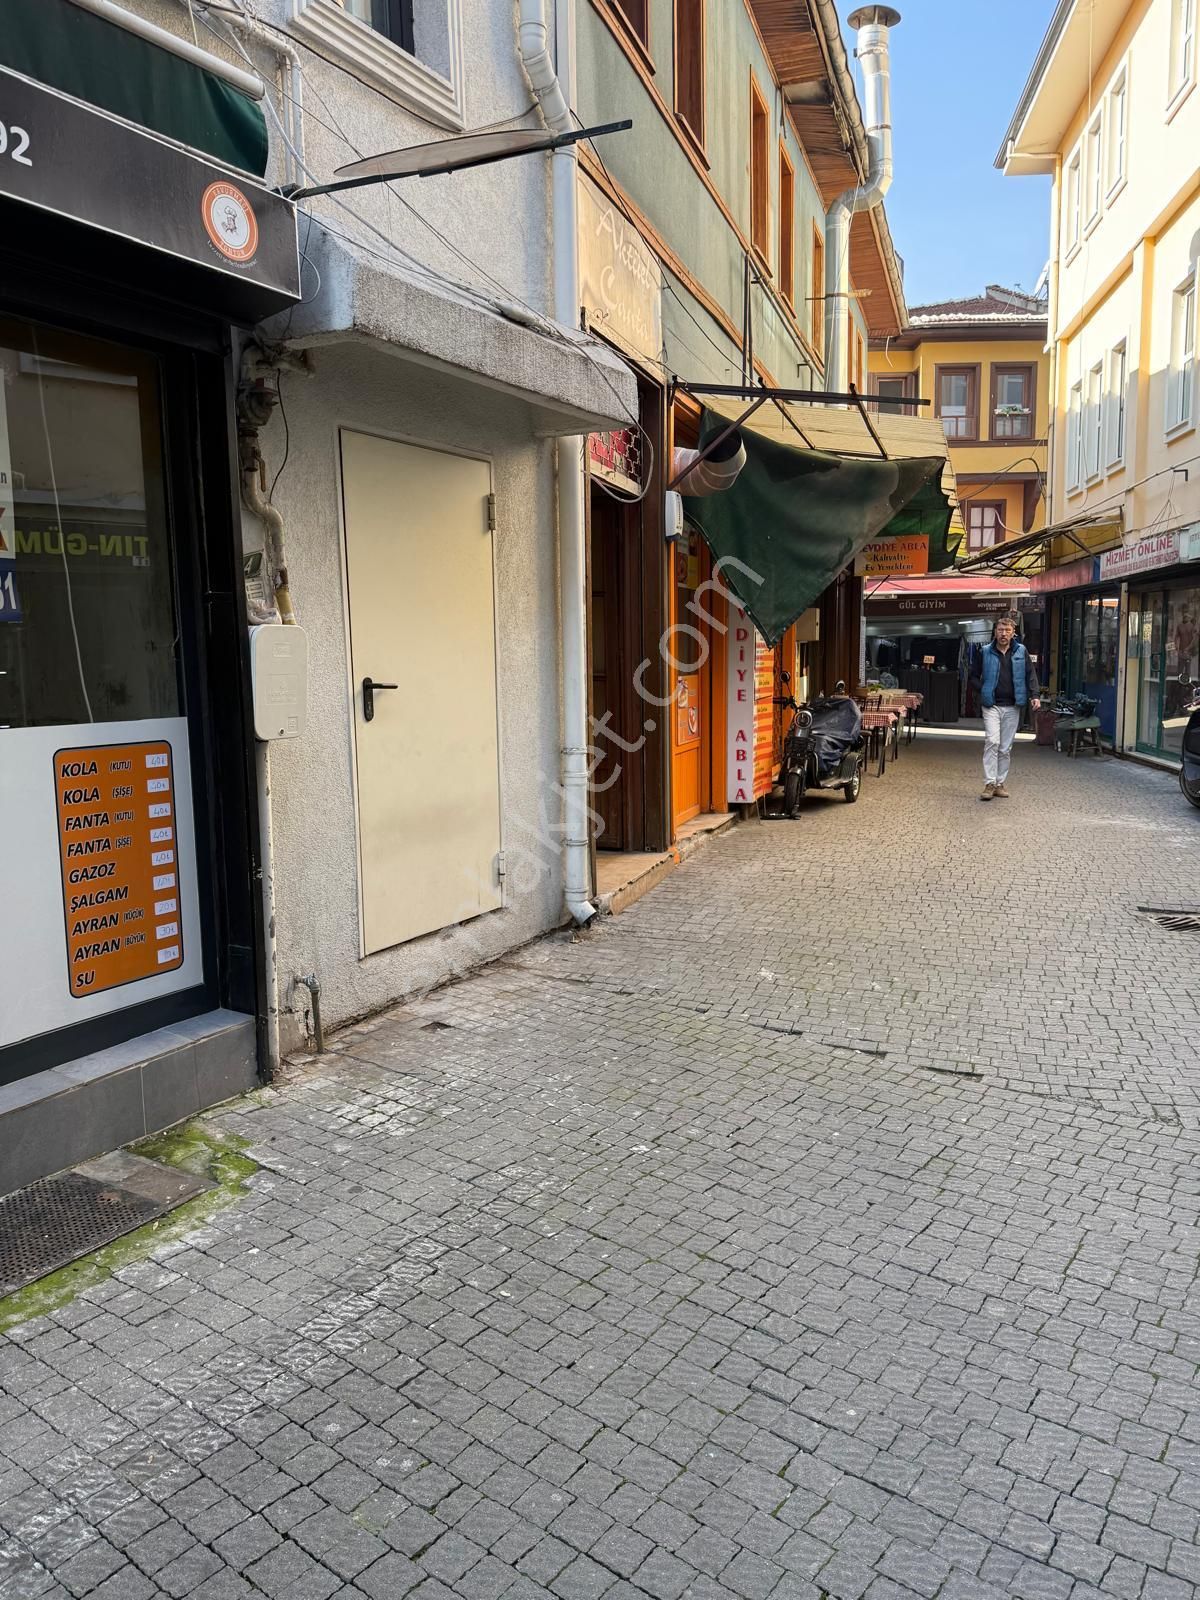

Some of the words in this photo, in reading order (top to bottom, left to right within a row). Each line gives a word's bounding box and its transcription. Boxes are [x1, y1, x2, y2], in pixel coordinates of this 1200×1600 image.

[863, 542, 896, 553] EVDİYE
[1106, 548, 1136, 567] HİZMET
[898, 600, 916, 609] GÜL
[919, 599, 946, 609] GİYİM
[736, 607, 748, 702] VDİYE
[61, 760, 98, 778] KOLA
[109, 760, 132, 773] (KUTU)
[735, 730, 748, 801] ABLA
[63, 789, 100, 805] KOLA
[112, 785, 133, 798] (ŞİŞE)
[65, 813, 110, 832] FANTA
[114, 810, 135, 823] (KUTU)
[67, 840, 112, 858] FANTA
[69, 863, 116, 884] GAZOZ
[70, 886, 129, 913] ŞALGAM
[72, 913, 119, 936] AYRAN
[74, 938, 121, 963] AYRAN
[76, 970, 95, 988] SU
